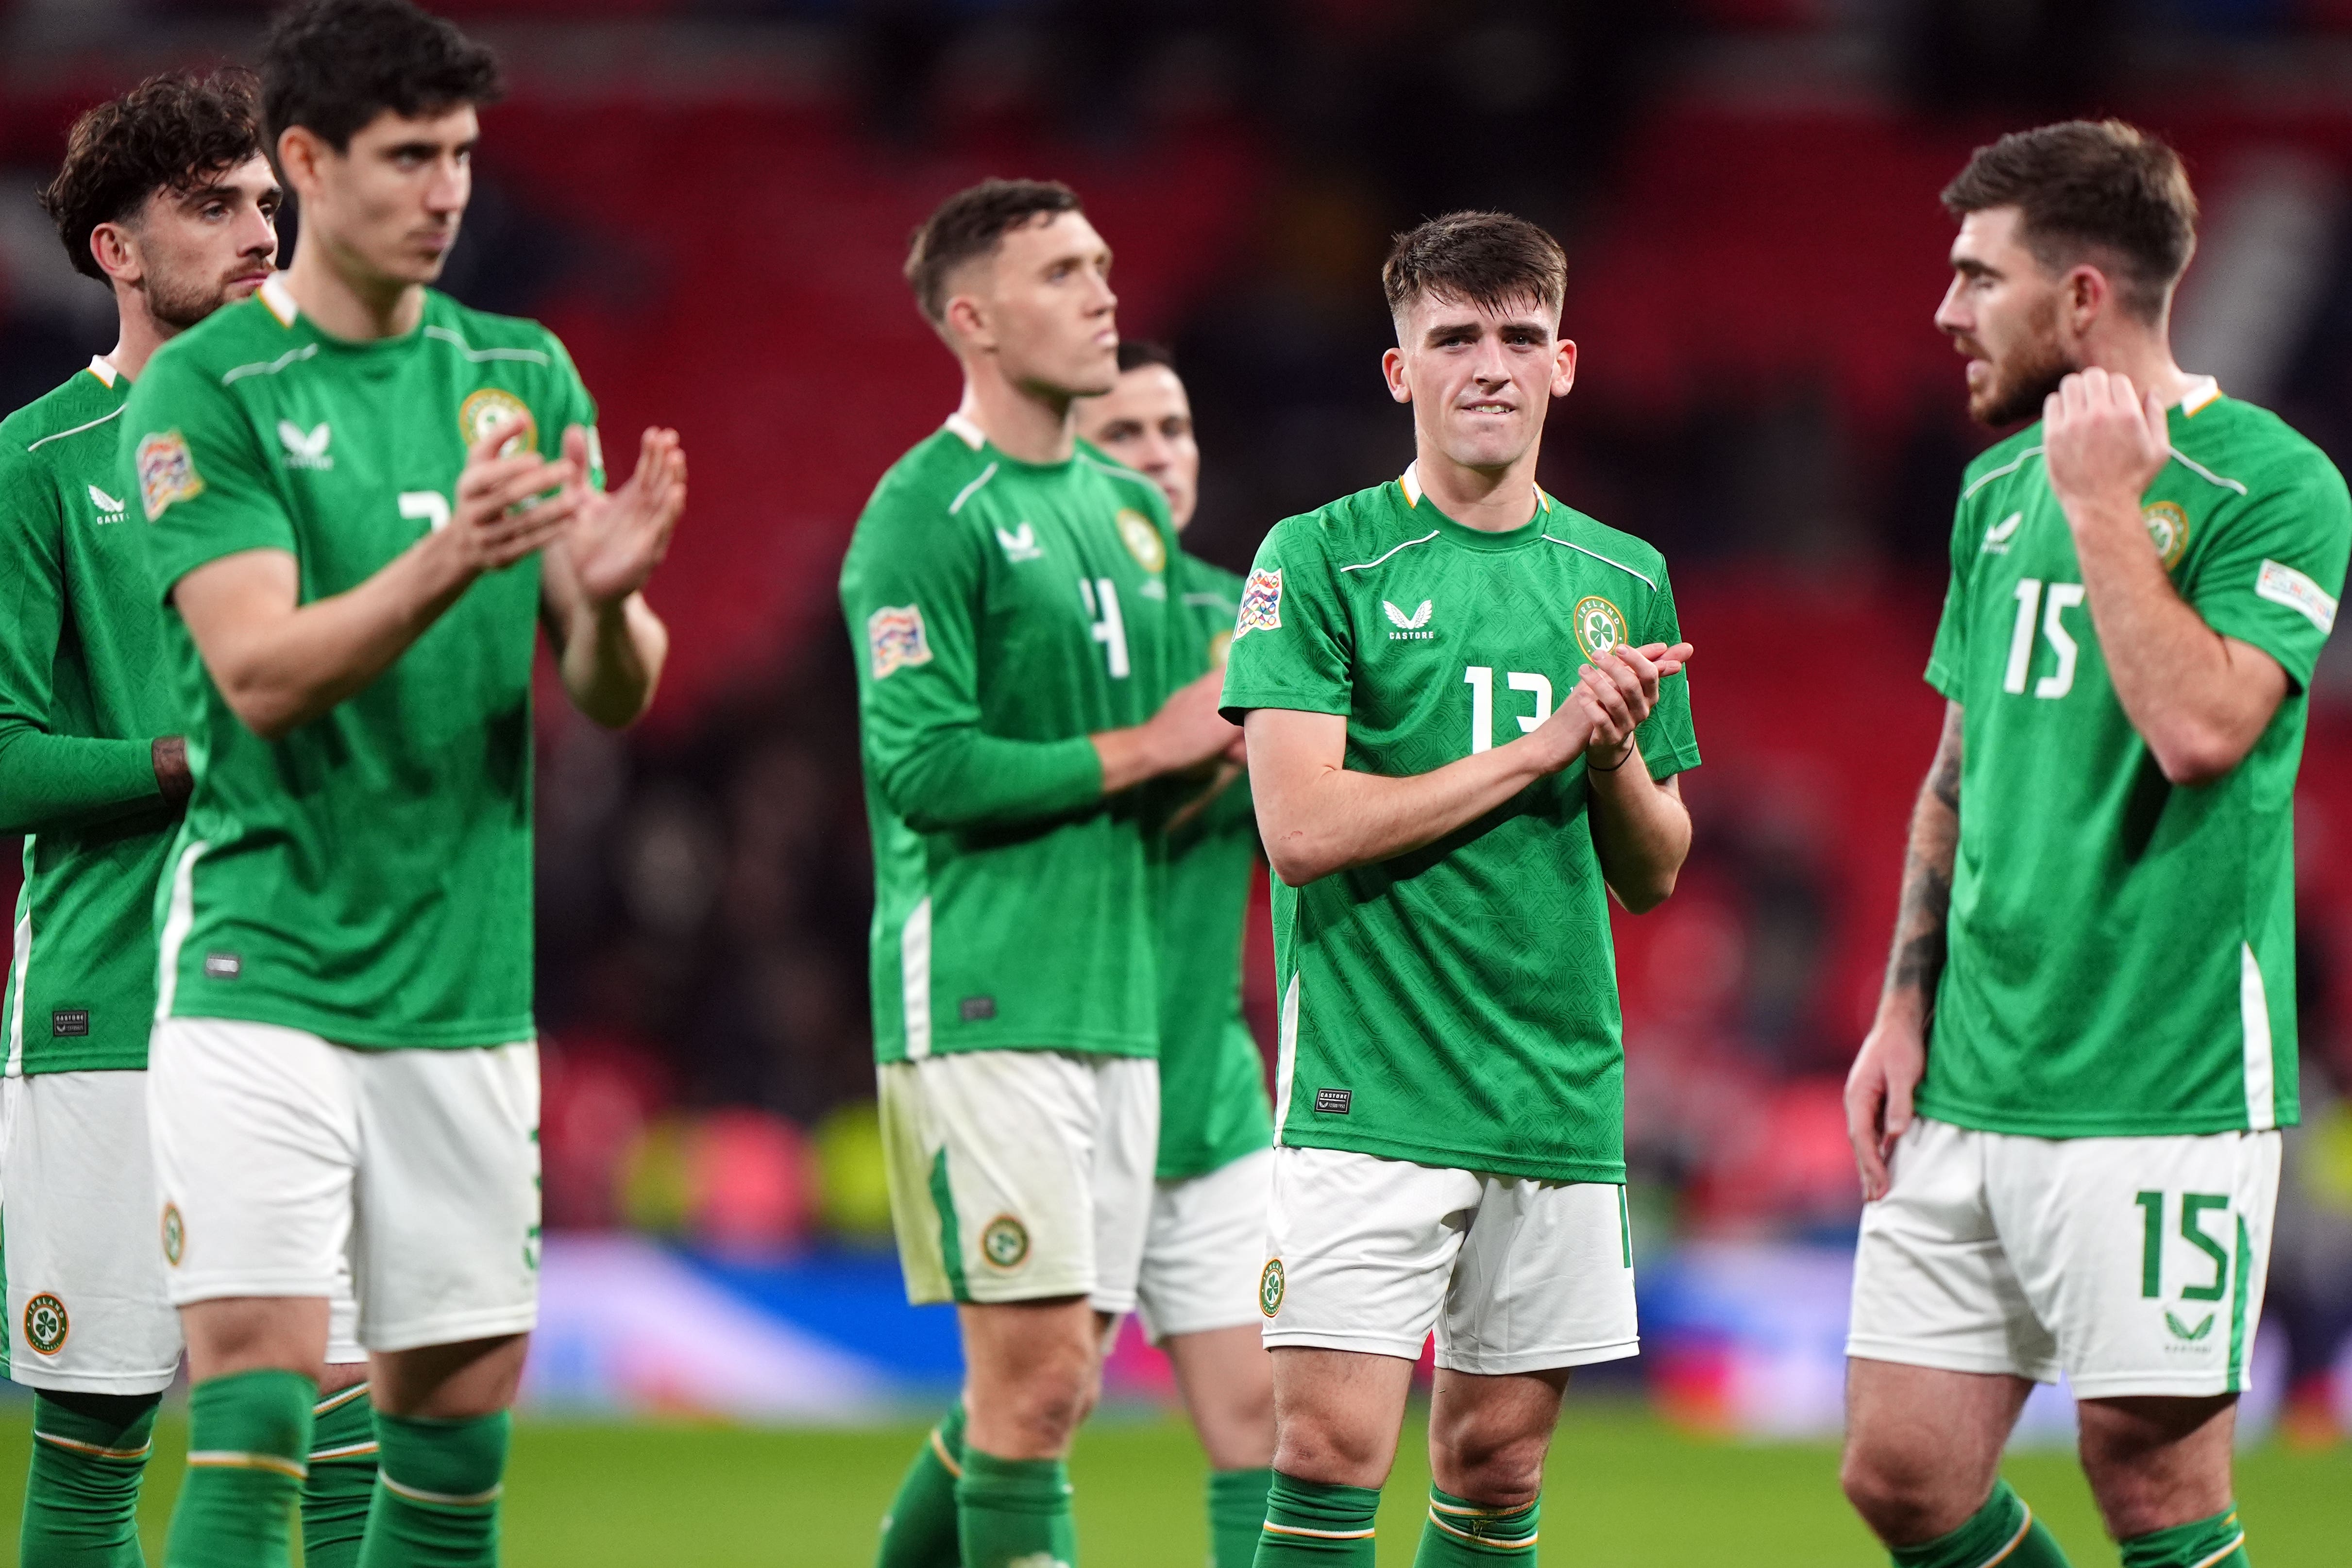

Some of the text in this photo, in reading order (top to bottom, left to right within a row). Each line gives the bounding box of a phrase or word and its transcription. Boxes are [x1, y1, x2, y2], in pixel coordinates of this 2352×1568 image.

[1078, 577, 1130, 678] 4
[1389, 631, 1434, 640] CASTORE
[1578, 600, 1620, 625] IRELAND
[2003, 577, 2085, 700] 15
[1463, 666, 1553, 755] 13
[2135, 1192, 2229, 1301] 15
